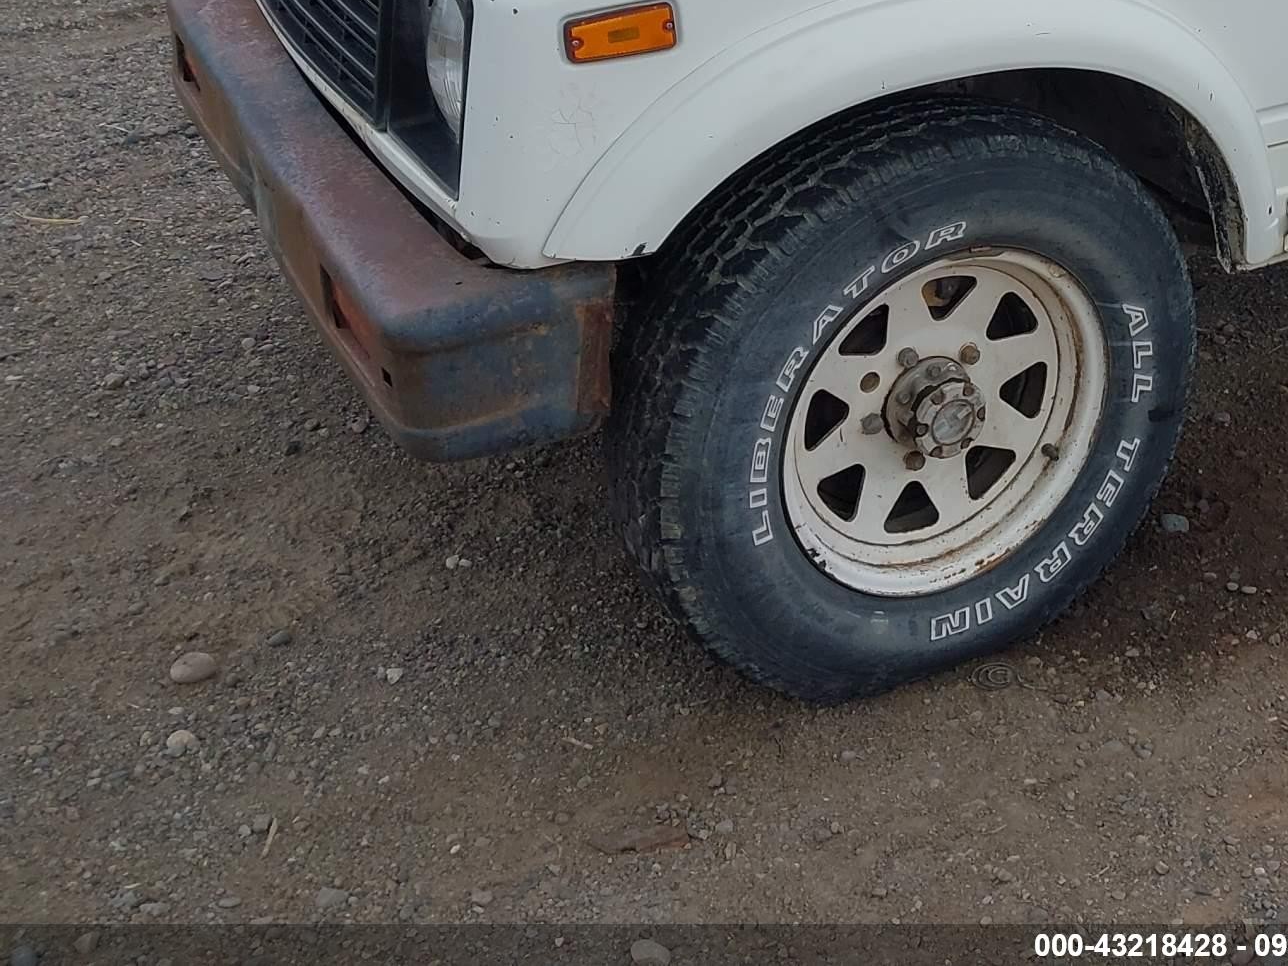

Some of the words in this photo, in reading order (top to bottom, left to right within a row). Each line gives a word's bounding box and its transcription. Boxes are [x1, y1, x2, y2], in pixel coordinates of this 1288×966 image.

[749, 221, 967, 546] LIBERATOR
[1121, 303, 1153, 404] ALL
[929, 437, 1142, 642] TERRAIN
